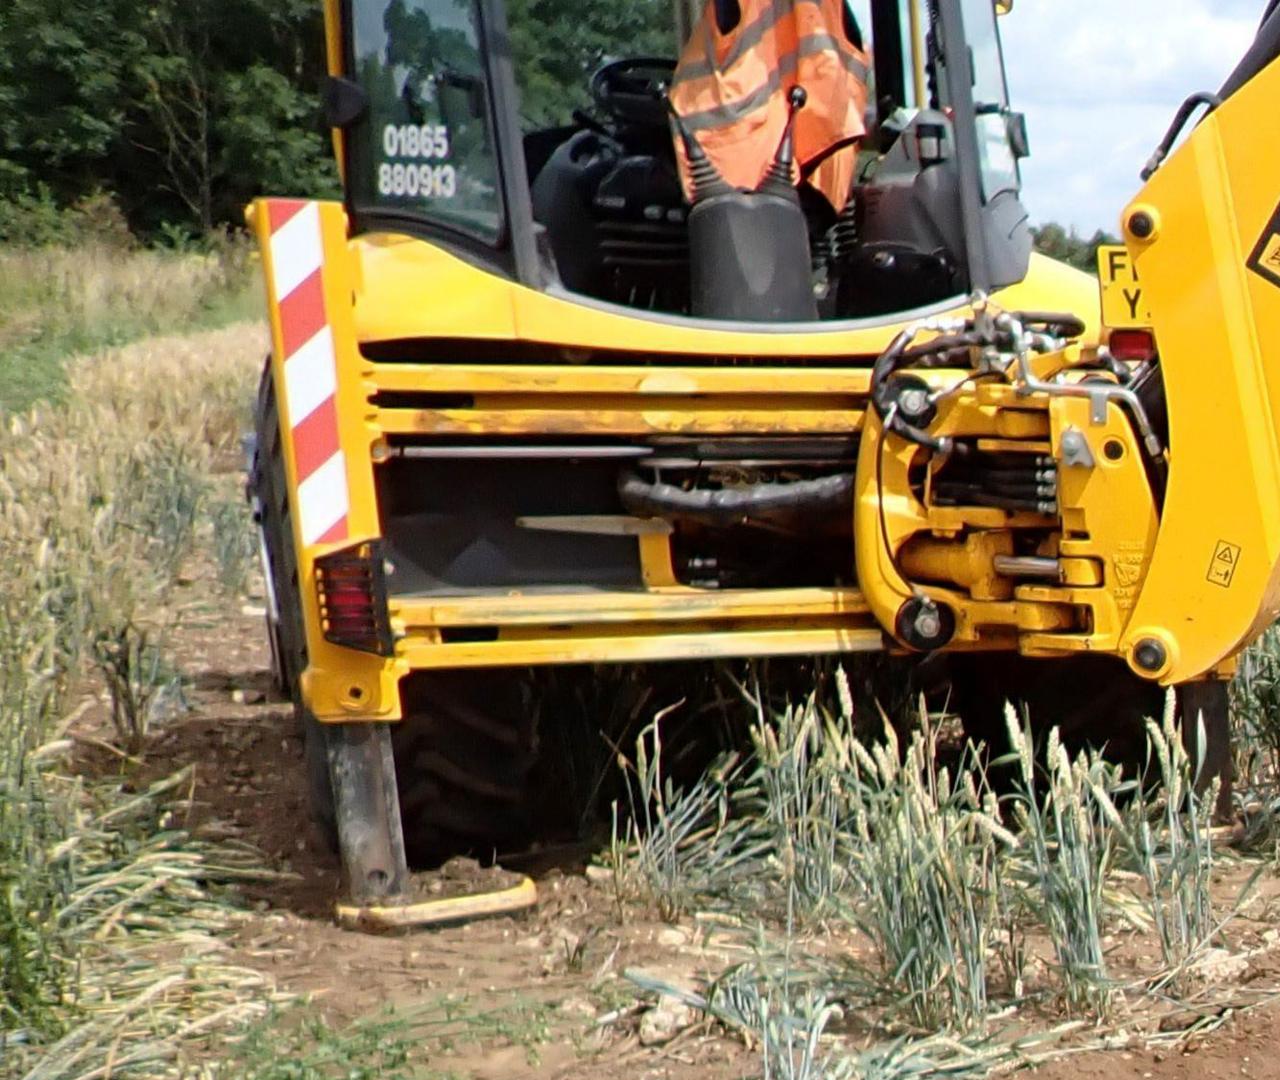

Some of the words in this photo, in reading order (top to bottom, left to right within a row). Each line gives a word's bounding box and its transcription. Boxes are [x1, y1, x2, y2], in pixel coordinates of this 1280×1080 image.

[383, 123, 449, 158] 01865
[378, 162, 457, 198] 880913
[1122, 288, 1151, 319] Y
